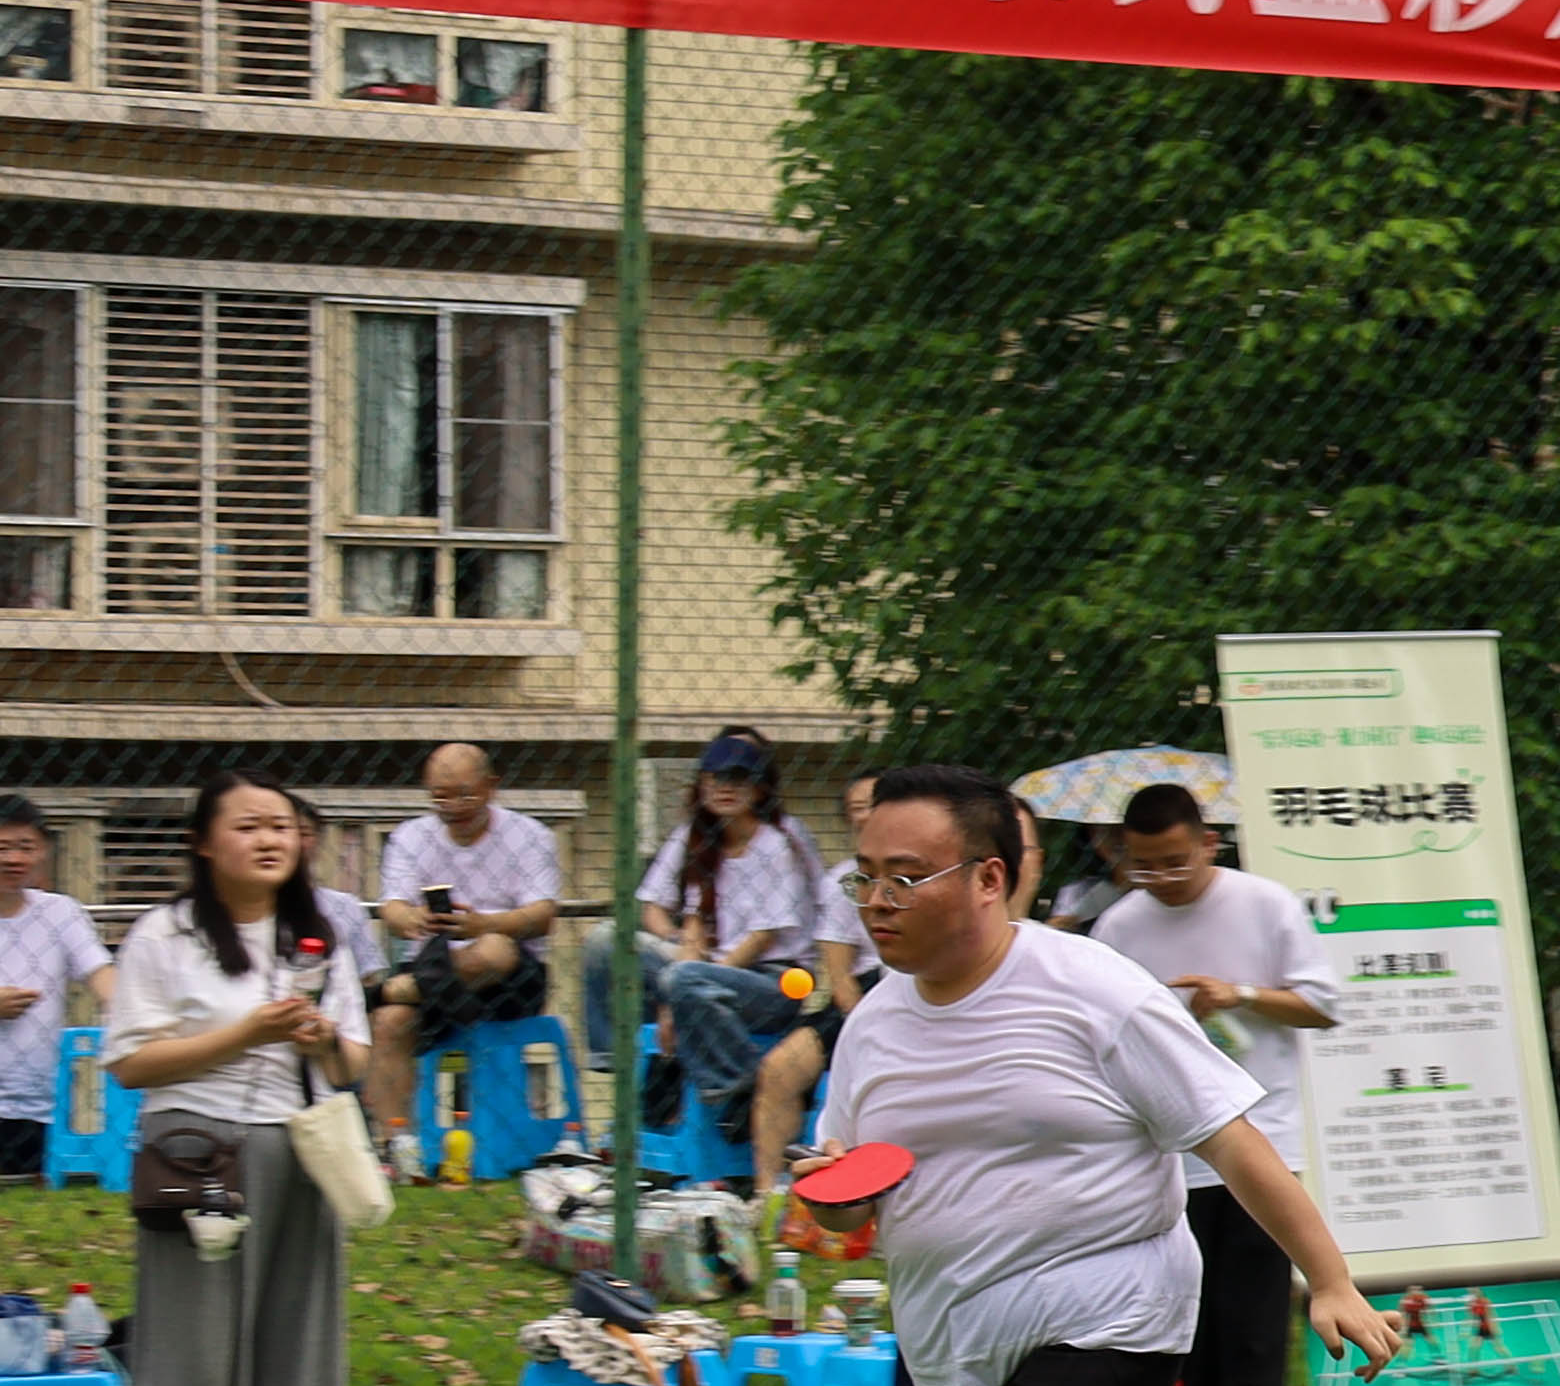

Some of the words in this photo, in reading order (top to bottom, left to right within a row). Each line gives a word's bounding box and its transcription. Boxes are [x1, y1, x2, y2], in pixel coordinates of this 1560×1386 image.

[1268, 781, 1480, 827] 羽毛球比赛
